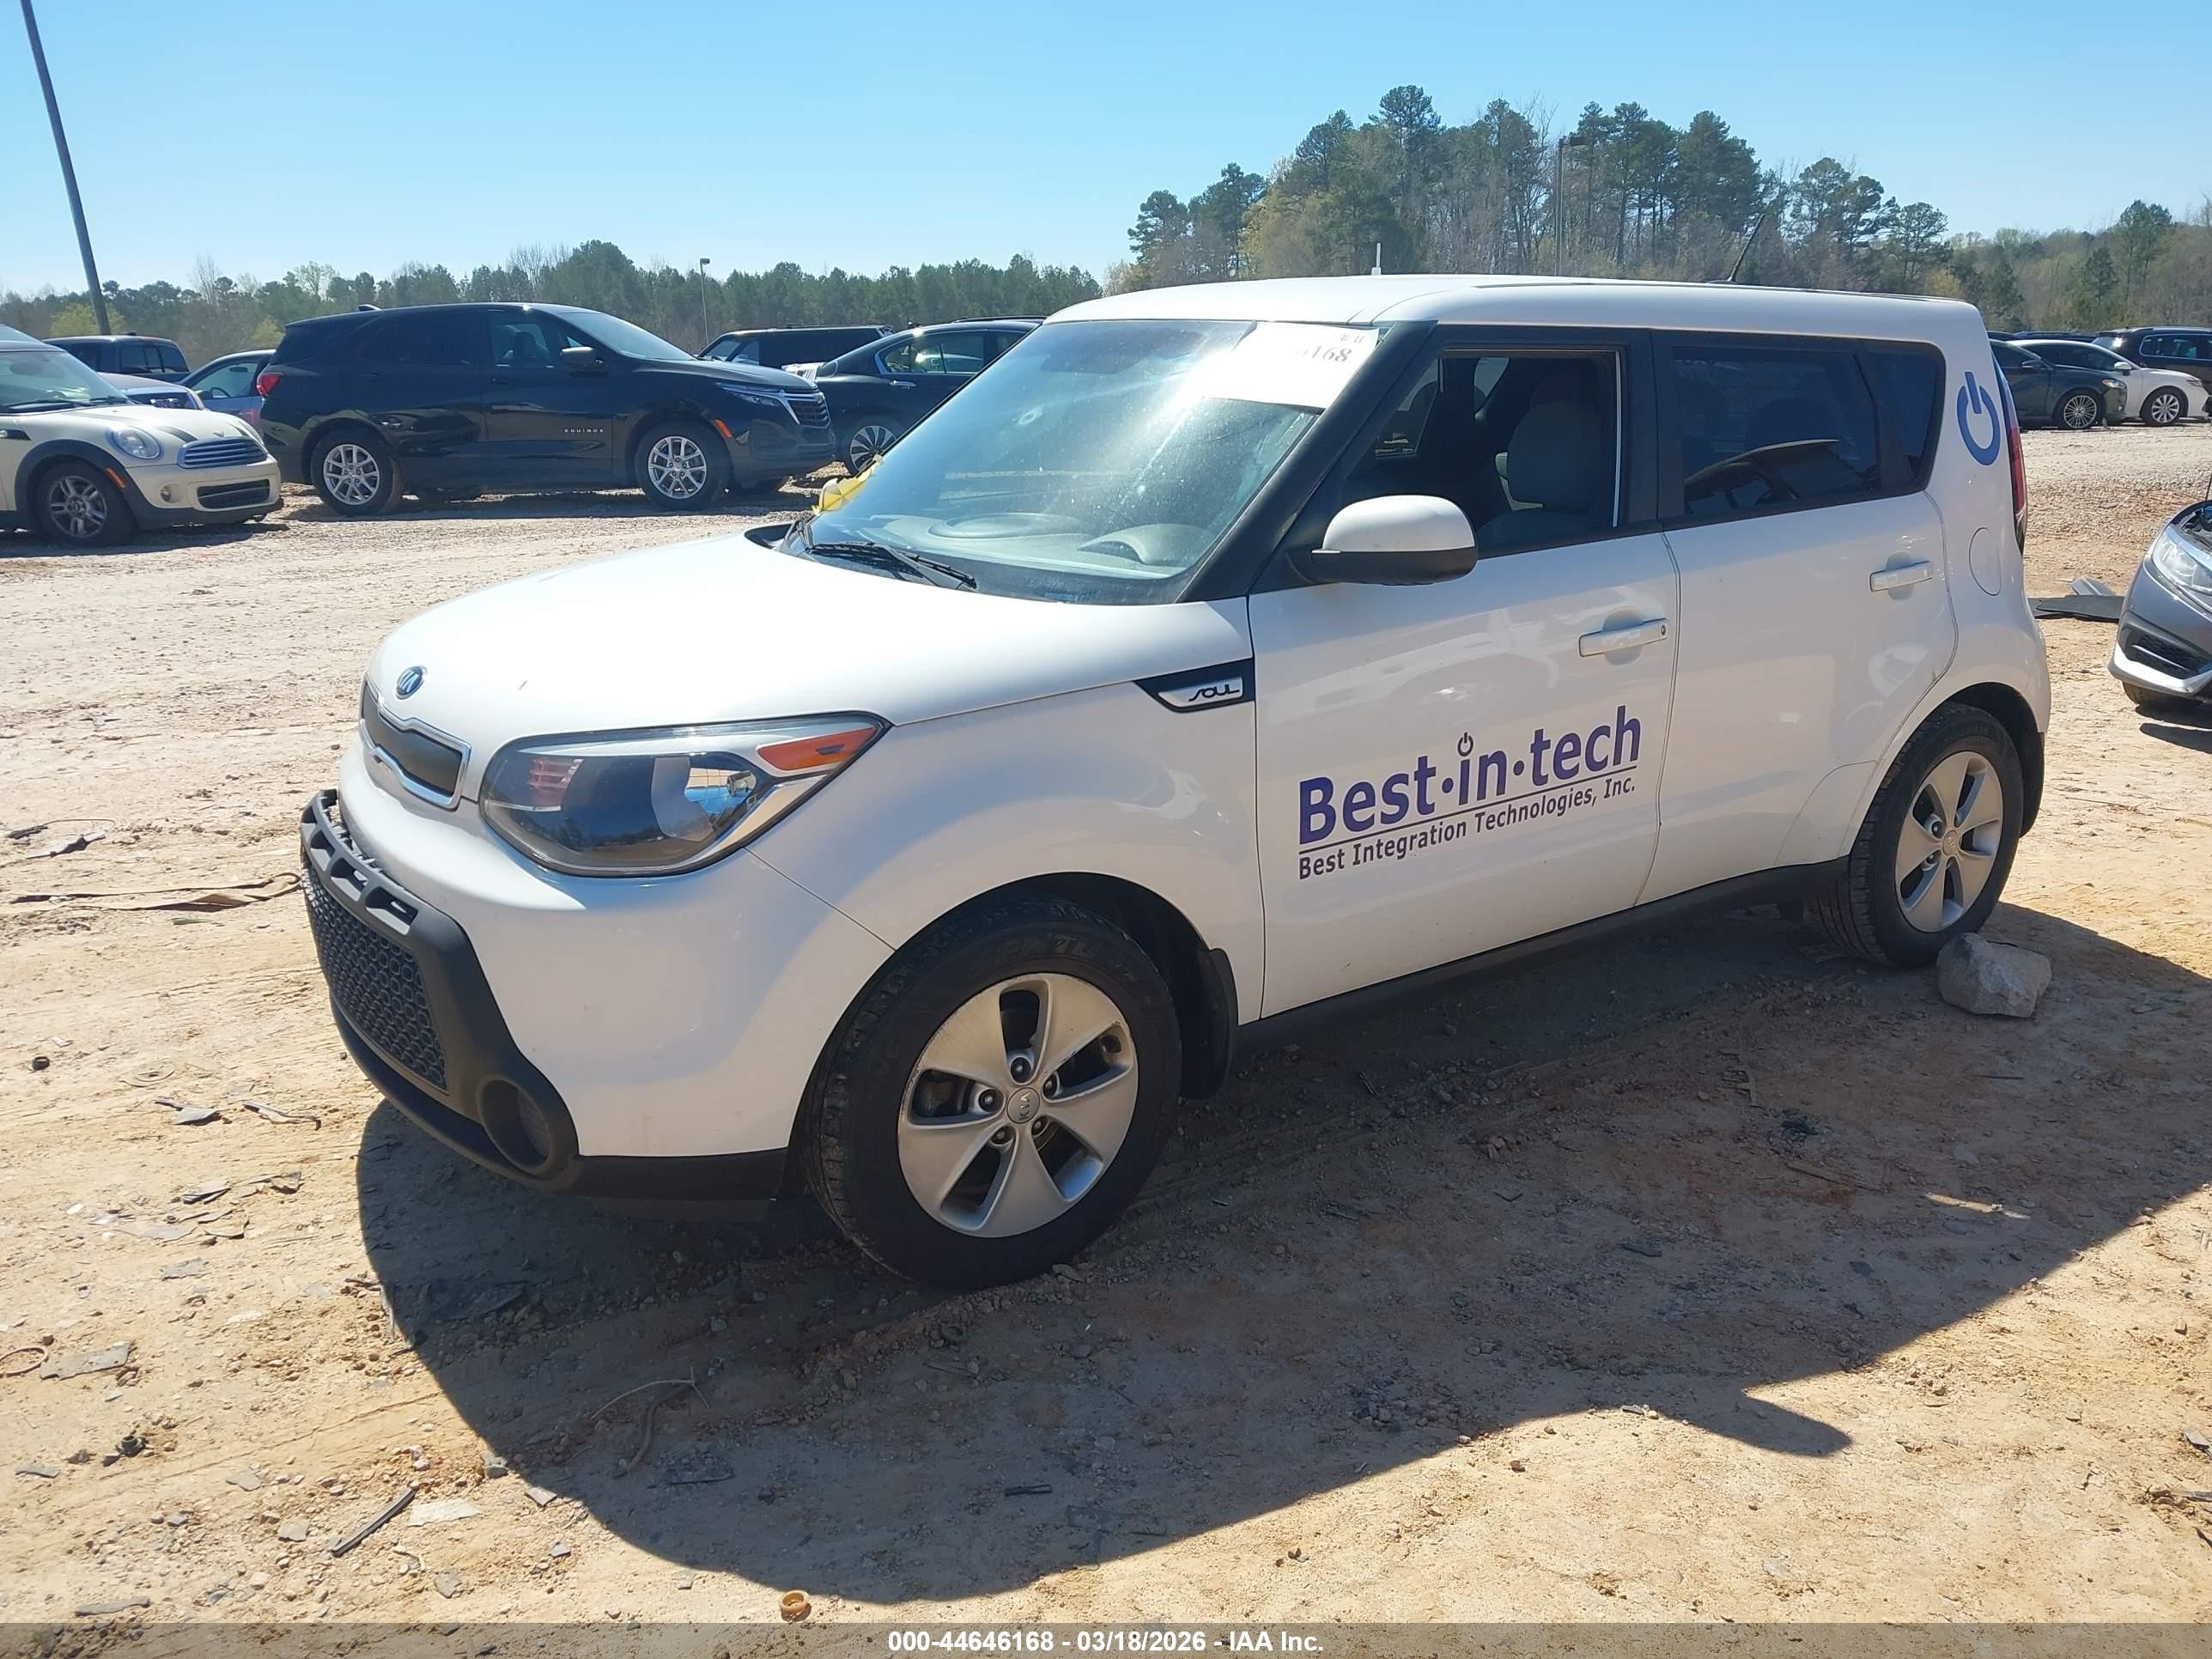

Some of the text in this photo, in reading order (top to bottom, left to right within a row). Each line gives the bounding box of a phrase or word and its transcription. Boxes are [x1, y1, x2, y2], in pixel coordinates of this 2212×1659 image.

[1188, 684, 1240, 702] SOUL
[1298, 775, 1636, 880] Best Integration Technologies, Inc.
